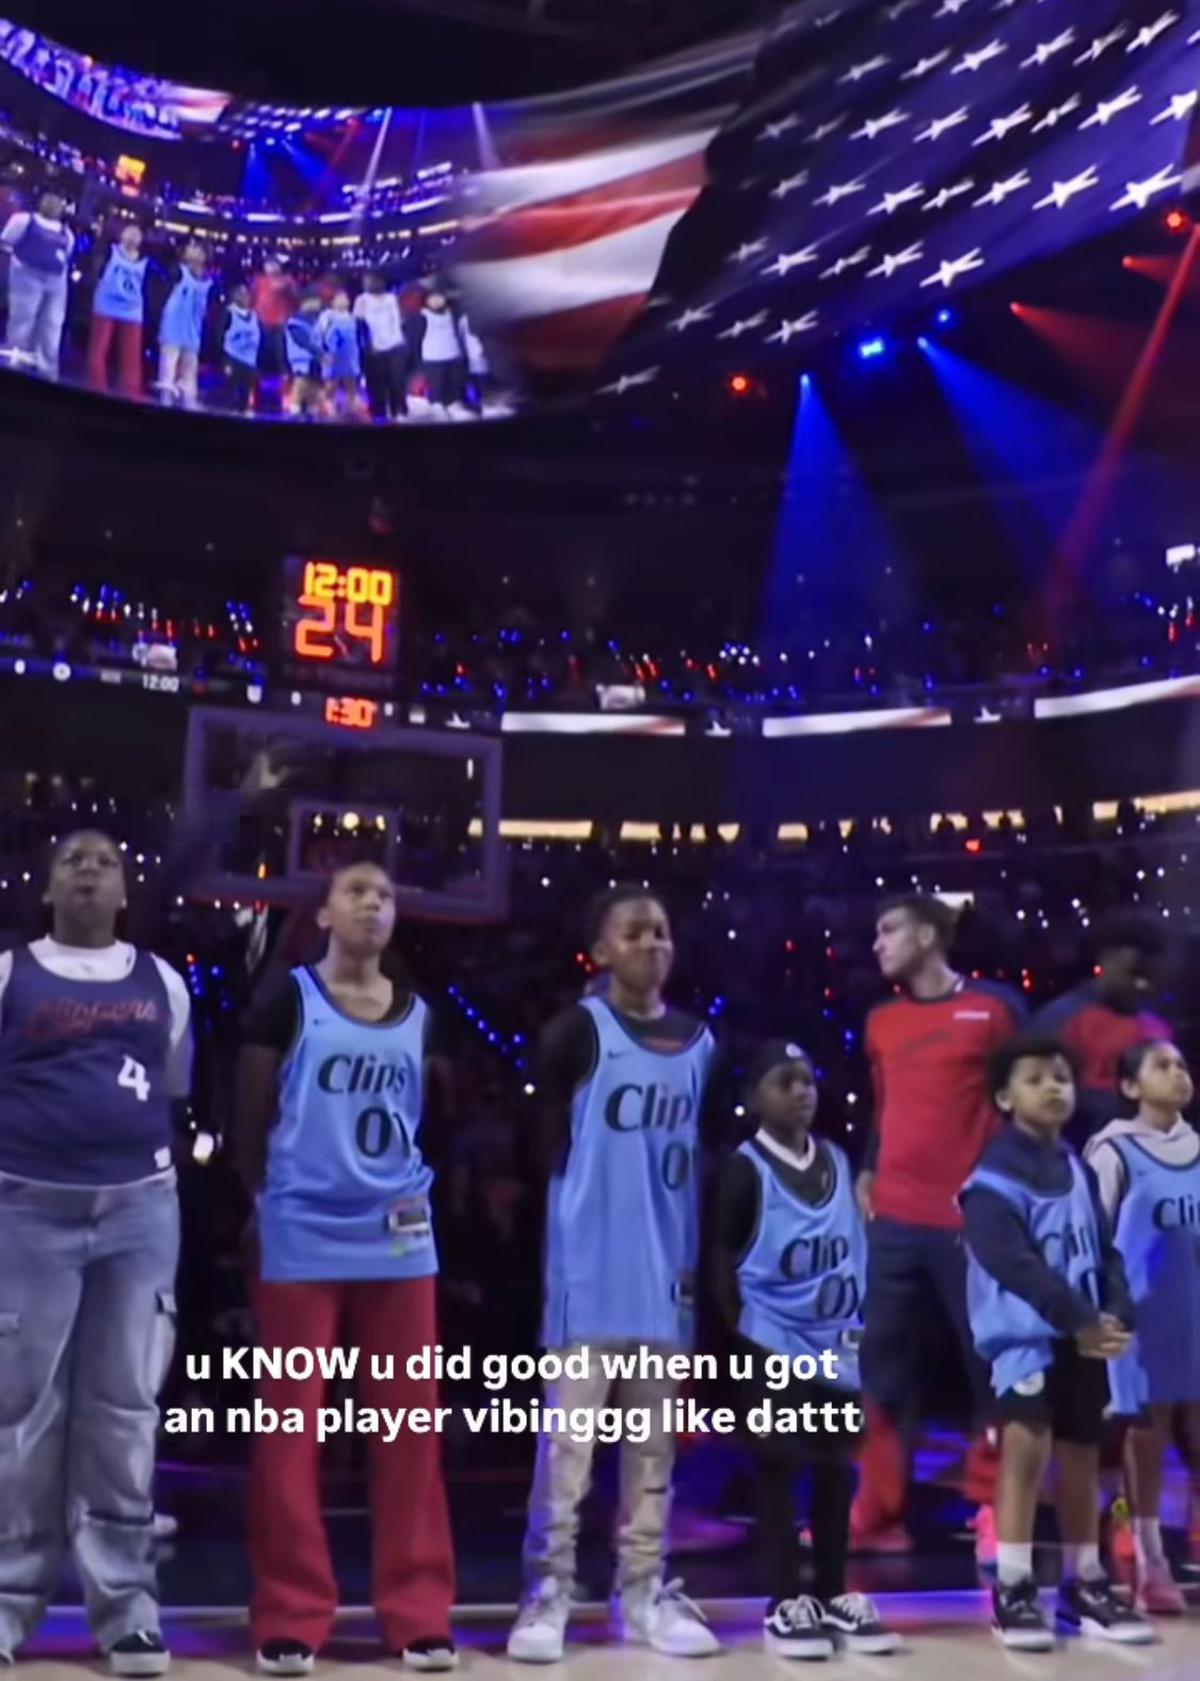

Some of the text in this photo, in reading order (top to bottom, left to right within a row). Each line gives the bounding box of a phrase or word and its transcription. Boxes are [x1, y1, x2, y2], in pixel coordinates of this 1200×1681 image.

[304, 561, 392, 606] 12:00
[295, 595, 384, 663] 24
[142, 673, 180, 692] 12:00
[117, 1054, 151, 1101] 4
[317, 1053, 406, 1095] Clips
